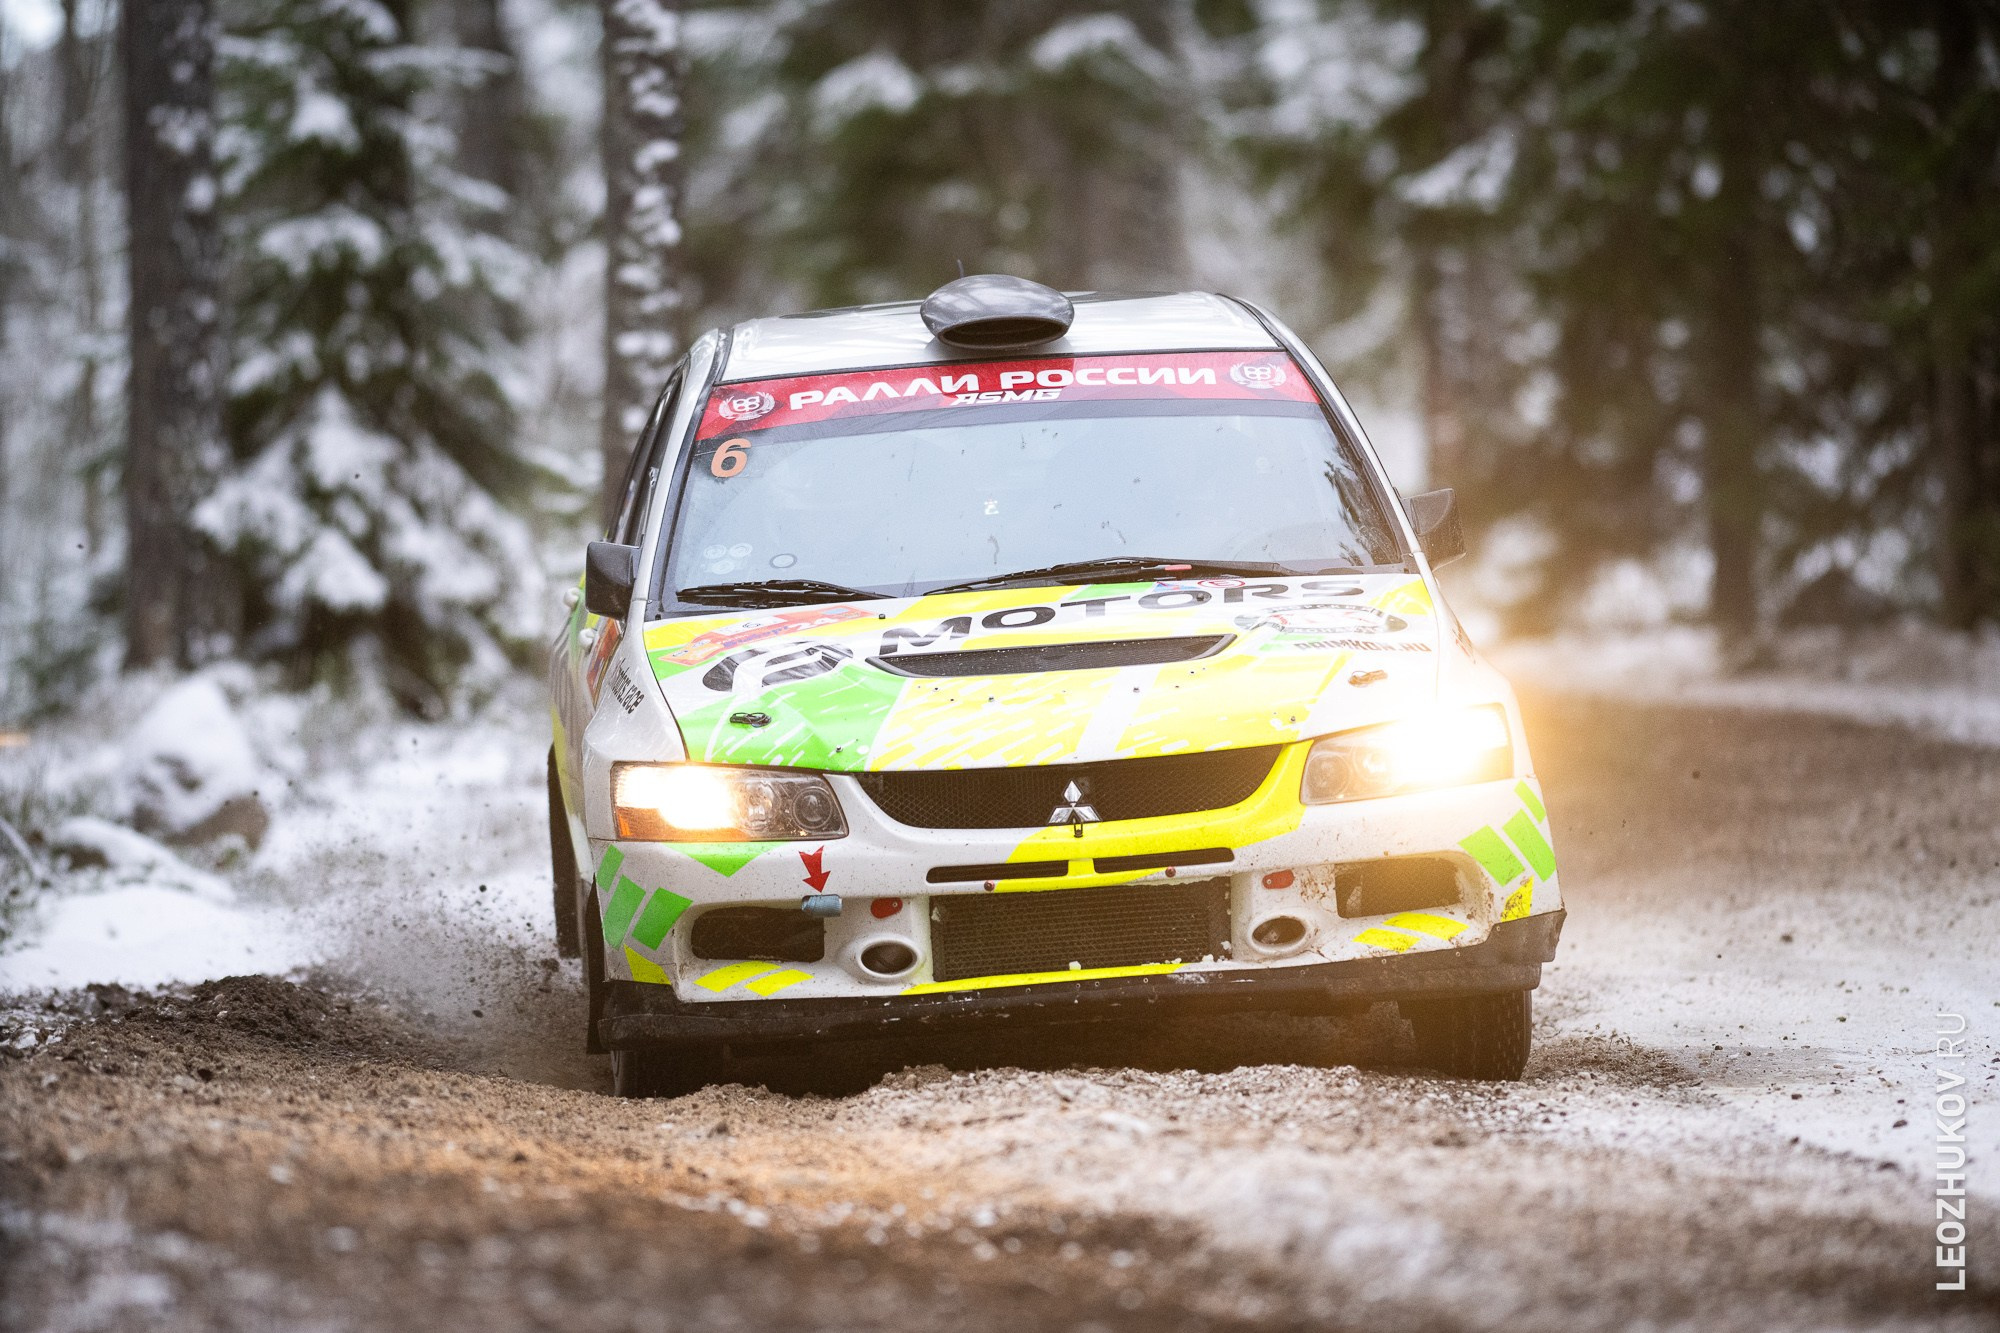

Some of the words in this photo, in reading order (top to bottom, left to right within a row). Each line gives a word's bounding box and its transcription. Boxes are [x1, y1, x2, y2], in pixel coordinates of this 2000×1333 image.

[789, 373, 980, 411] РАЛЛИ
[1000, 368, 1217, 390] РОССИИ
[711, 438, 752, 478] 6
[878, 579, 1364, 656] MOTORS
